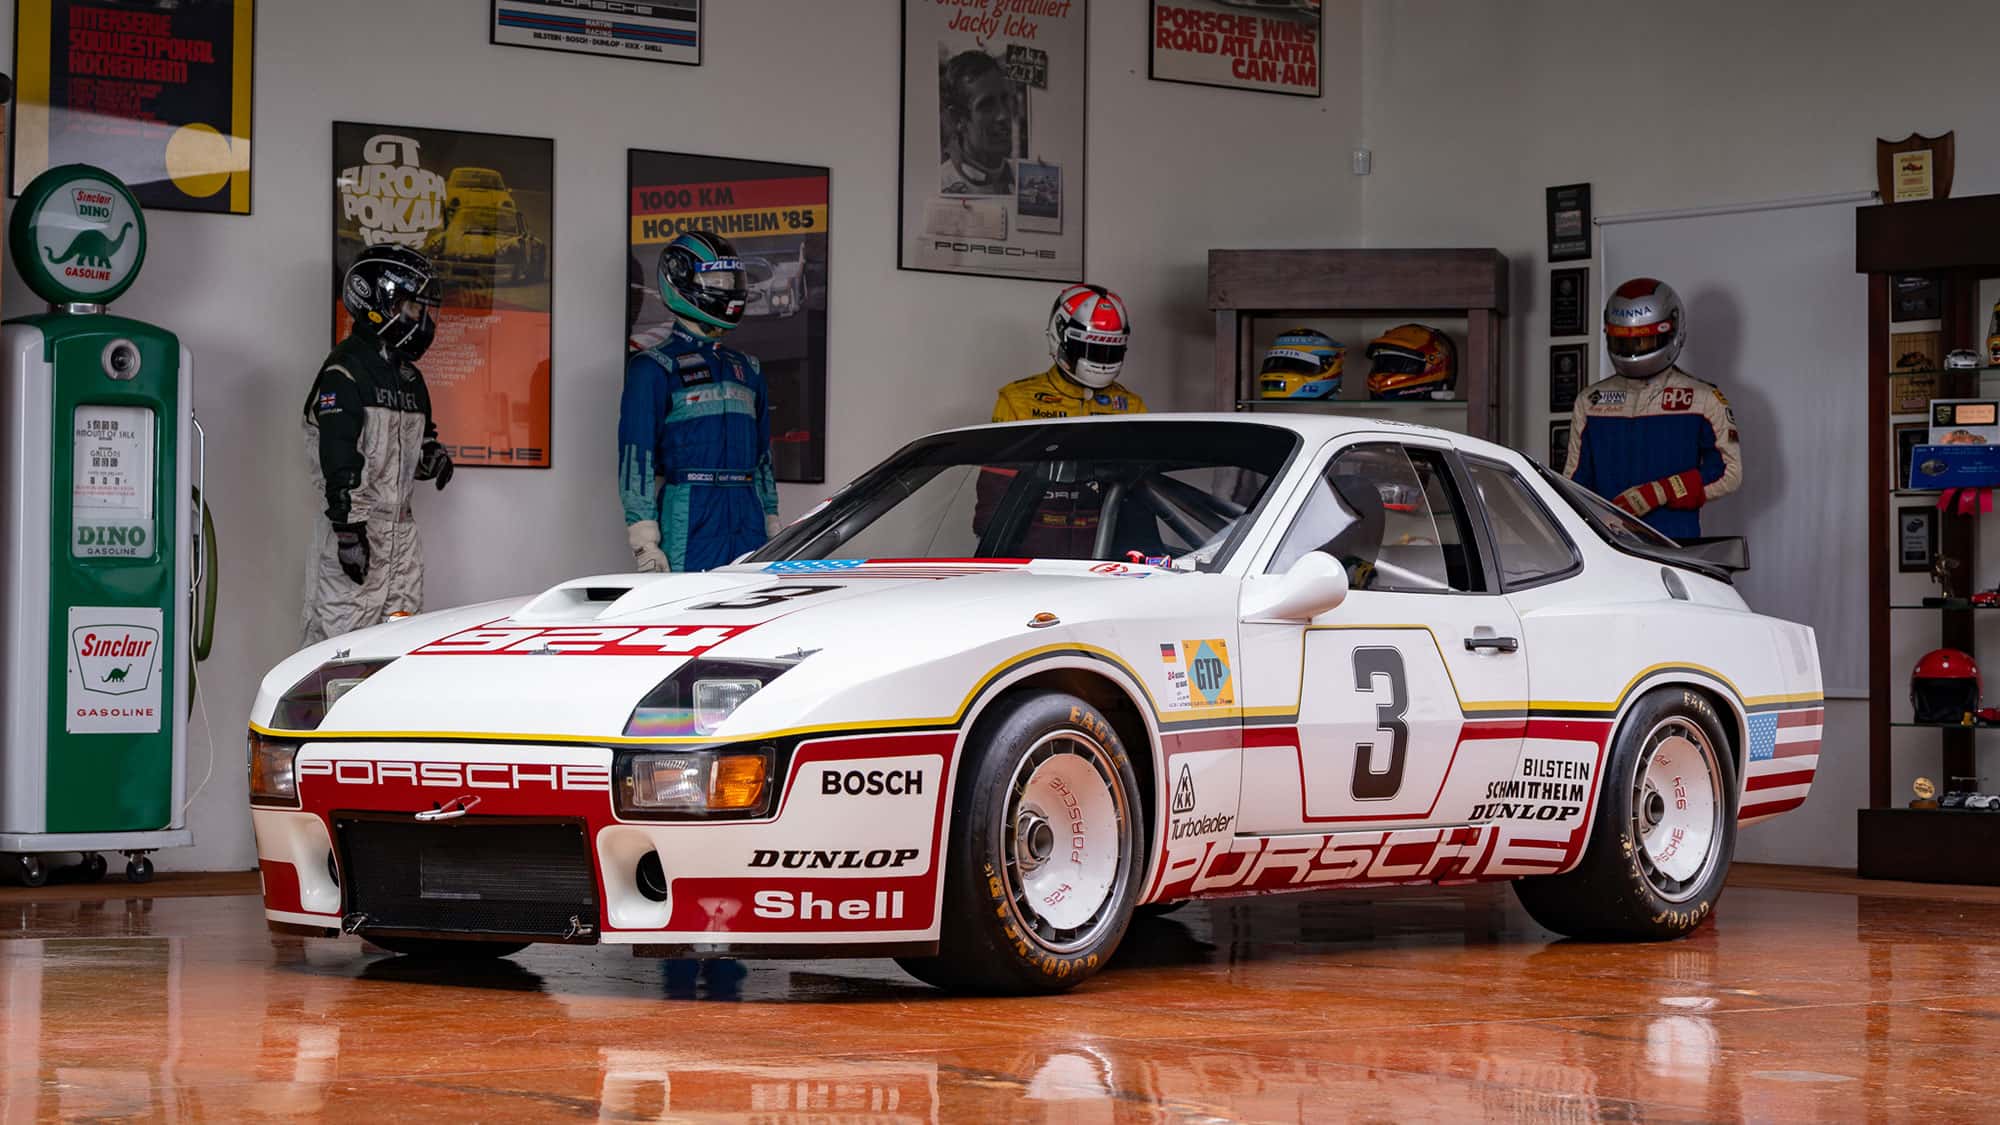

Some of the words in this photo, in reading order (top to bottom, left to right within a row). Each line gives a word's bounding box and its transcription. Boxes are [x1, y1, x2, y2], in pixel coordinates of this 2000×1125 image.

[949, 10, 999, 40] Jacky
[1004, 14, 1038, 40] Ickx
[1157, 5, 1257, 38] PORSCHE
[1261, 18, 1316, 45] WINS
[592, 38, 621, 48] DUNLOP
[1156, 27, 1218, 54] ROAD
[1221, 34, 1316, 66] ATLANTA
[363, 134, 421, 168] GT
[77, 191, 112, 205] Sinclair
[641, 189, 692, 210] 1000
[699, 187, 735, 207] KM
[80, 205, 110, 219] DINO
[342, 195, 442, 232] POKAL
[643, 211, 780, 239] HOCKENHEIM
[934, 241, 1057, 260] PORSCHE
[65, 266, 111, 281] GASOLINE
[448, 446, 543, 461] SCHE
[77, 525, 146, 547] DINO
[88, 547, 136, 556] GASOLINE
[81, 633, 152, 659] Sinclair
[1195, 657, 1223, 690] GTP
[76, 707, 154, 717] GASOLINE
[1350, 645, 1409, 801] 3
[298, 760, 609, 792] PORSCHE
[1523, 758, 1590, 781] BILSTEIN
[821, 770, 923, 796] BOSCH
[1486, 780, 1584, 802] SCHMITTHELM
[1673, 777, 1687, 811] 924
[1049, 777, 1085, 865] PORSCHE
[1467, 802, 1581, 821] DUNLOP
[1171, 812, 1234, 840] Turbolader
[747, 848, 919, 870] DUNLOP
[1152, 823, 1573, 903] PORSCHE
[753, 889, 905, 921] Shell
[1043, 882, 1072, 906] 924
